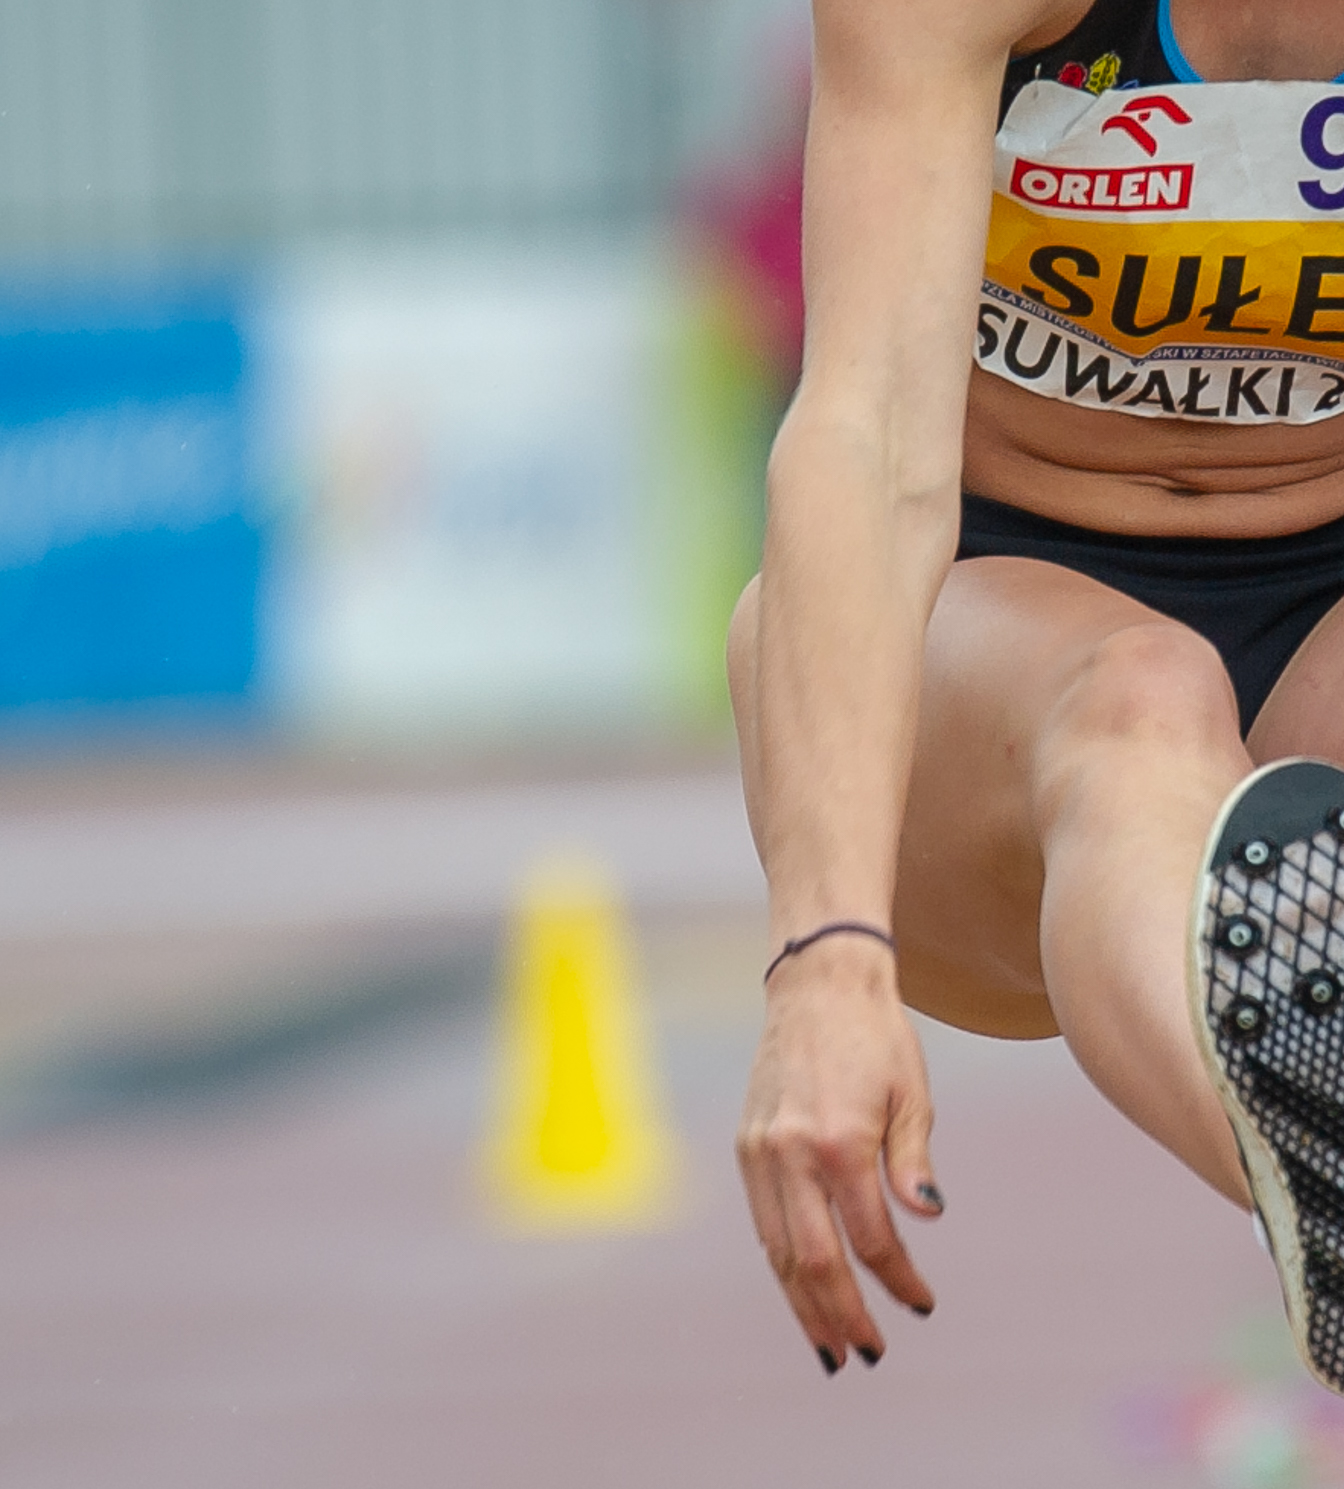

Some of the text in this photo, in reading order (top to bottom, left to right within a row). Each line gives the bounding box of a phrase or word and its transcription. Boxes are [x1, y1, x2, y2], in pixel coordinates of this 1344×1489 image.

[1020, 168, 1183, 206] ORLEN
[977, 303, 1297, 417] SUWAŁKI
[1146, 347, 1179, 359] SKI
[1181, 348, 1199, 359] W
